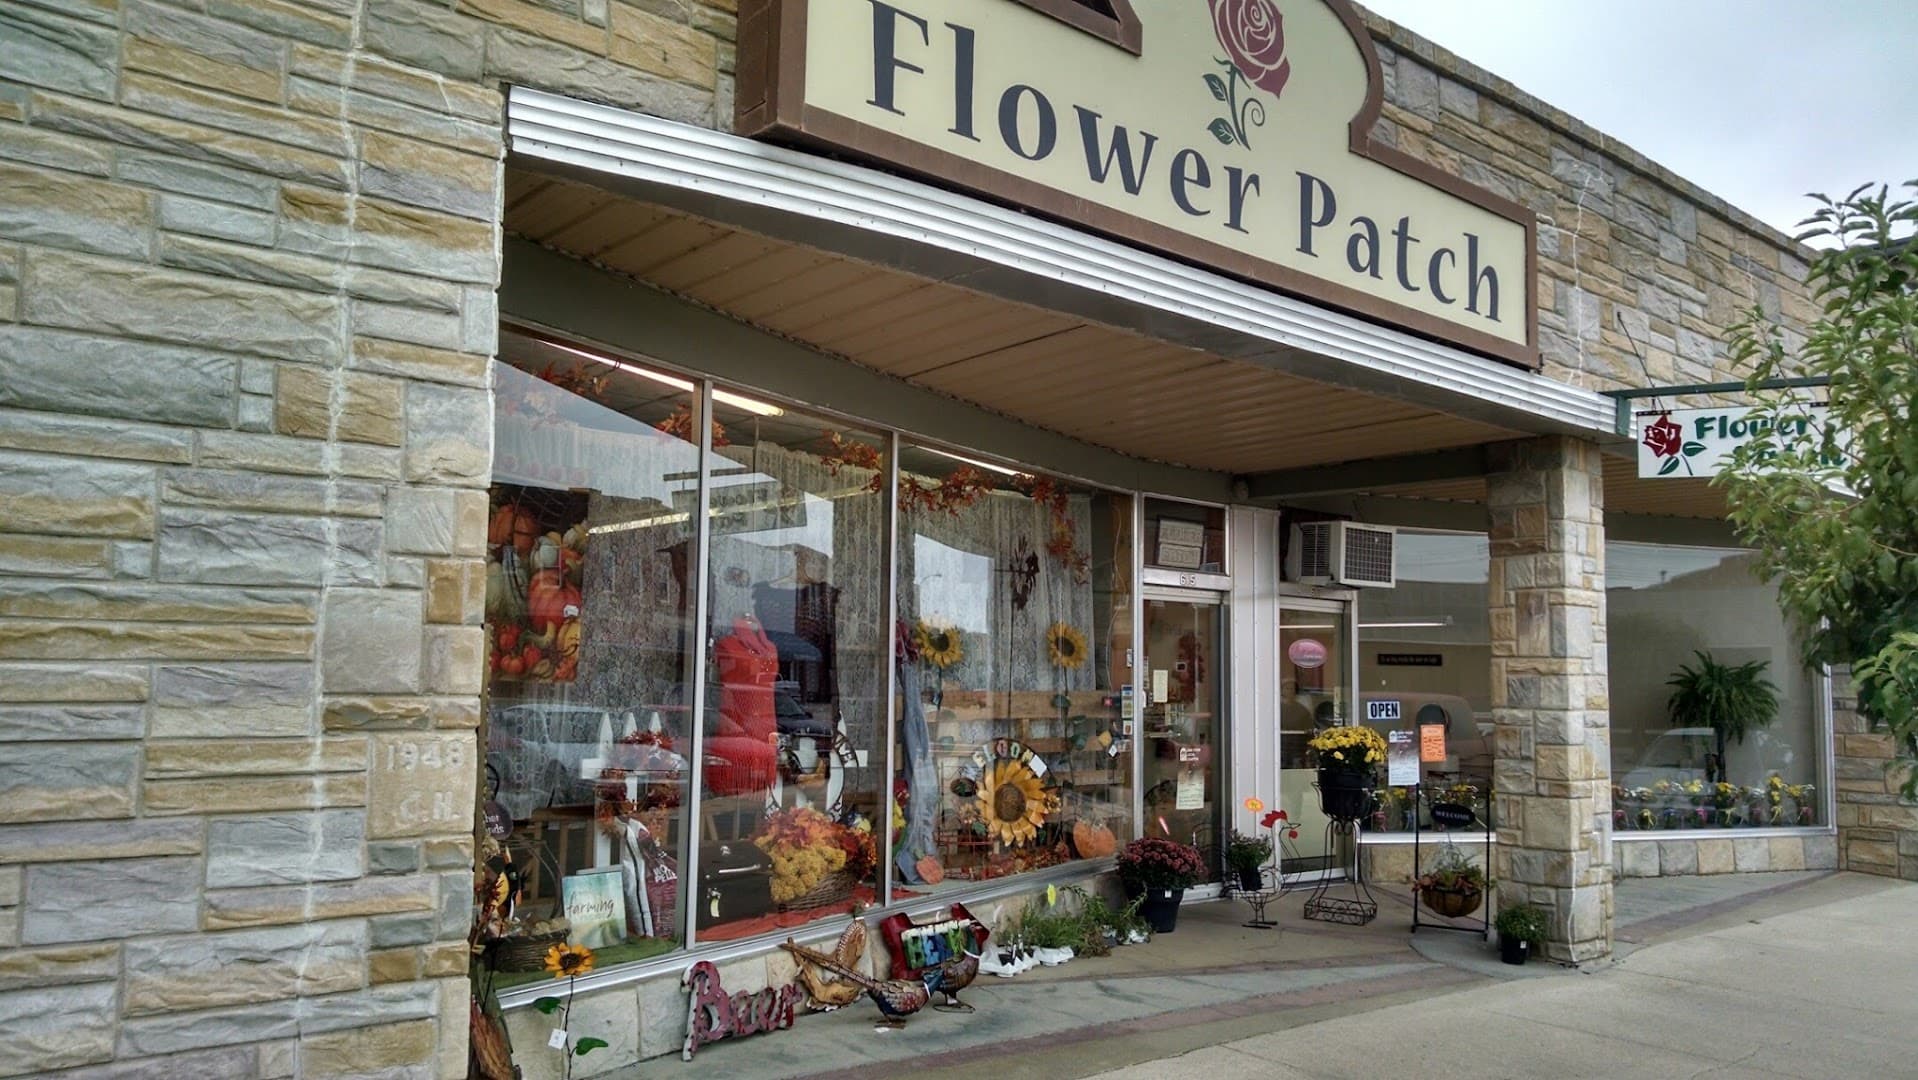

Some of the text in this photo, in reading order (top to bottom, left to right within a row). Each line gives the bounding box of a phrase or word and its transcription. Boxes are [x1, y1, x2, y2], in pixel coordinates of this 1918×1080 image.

[867, 0, 1501, 322] Flower Patch
[1370, 703, 1398, 718] OPEN
[386, 742, 464, 772] 1948
[1435, 809, 1470, 821] WELCOME
[566, 891, 614, 918] farming
[681, 961, 803, 1062] Beer
